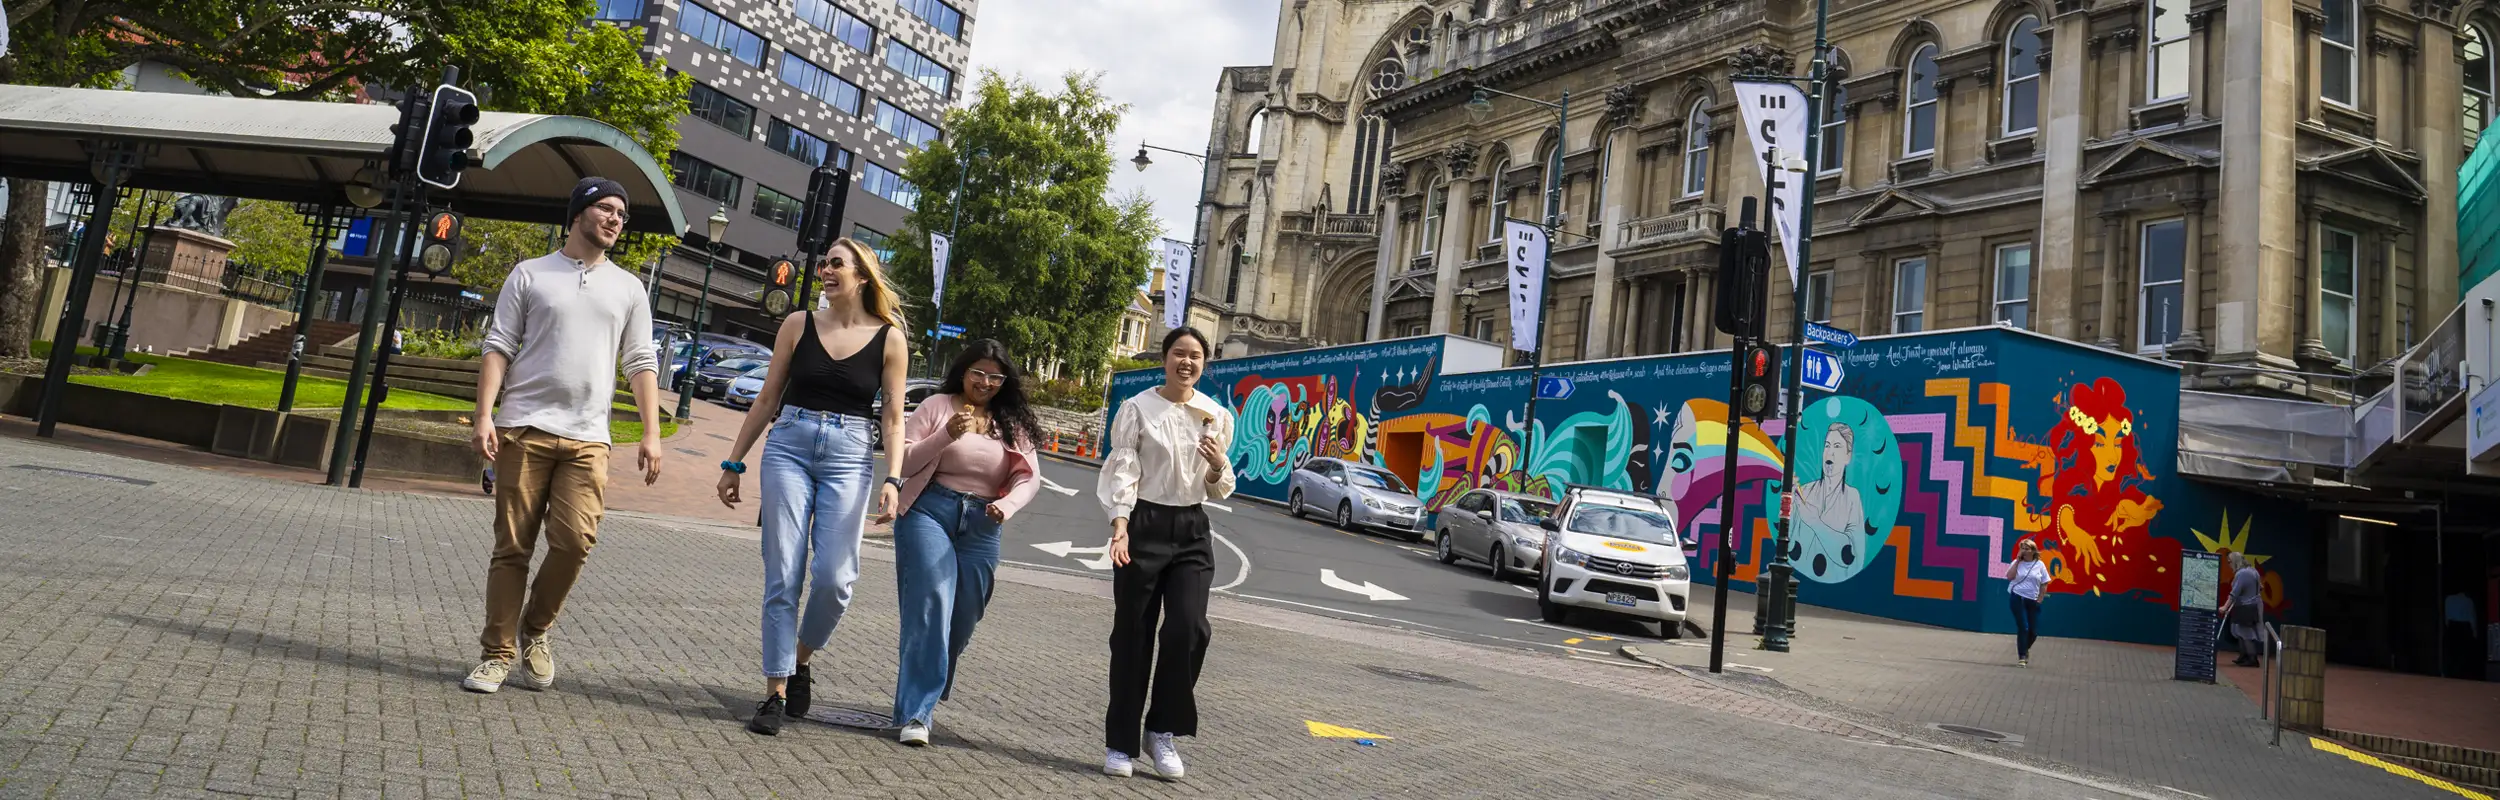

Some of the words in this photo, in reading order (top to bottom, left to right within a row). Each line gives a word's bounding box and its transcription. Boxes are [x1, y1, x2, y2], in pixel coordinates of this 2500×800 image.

[1806, 323, 1848, 345] Backpackers
[1848, 348, 1880, 368] Knowledge
[1886, 345, 1901, 367] And
[1924, 341, 1956, 364] yourself
[1653, 364, 1665, 379] And
[1665, 364, 1674, 376] the
[1607, 592, 1635, 604] NPB429
